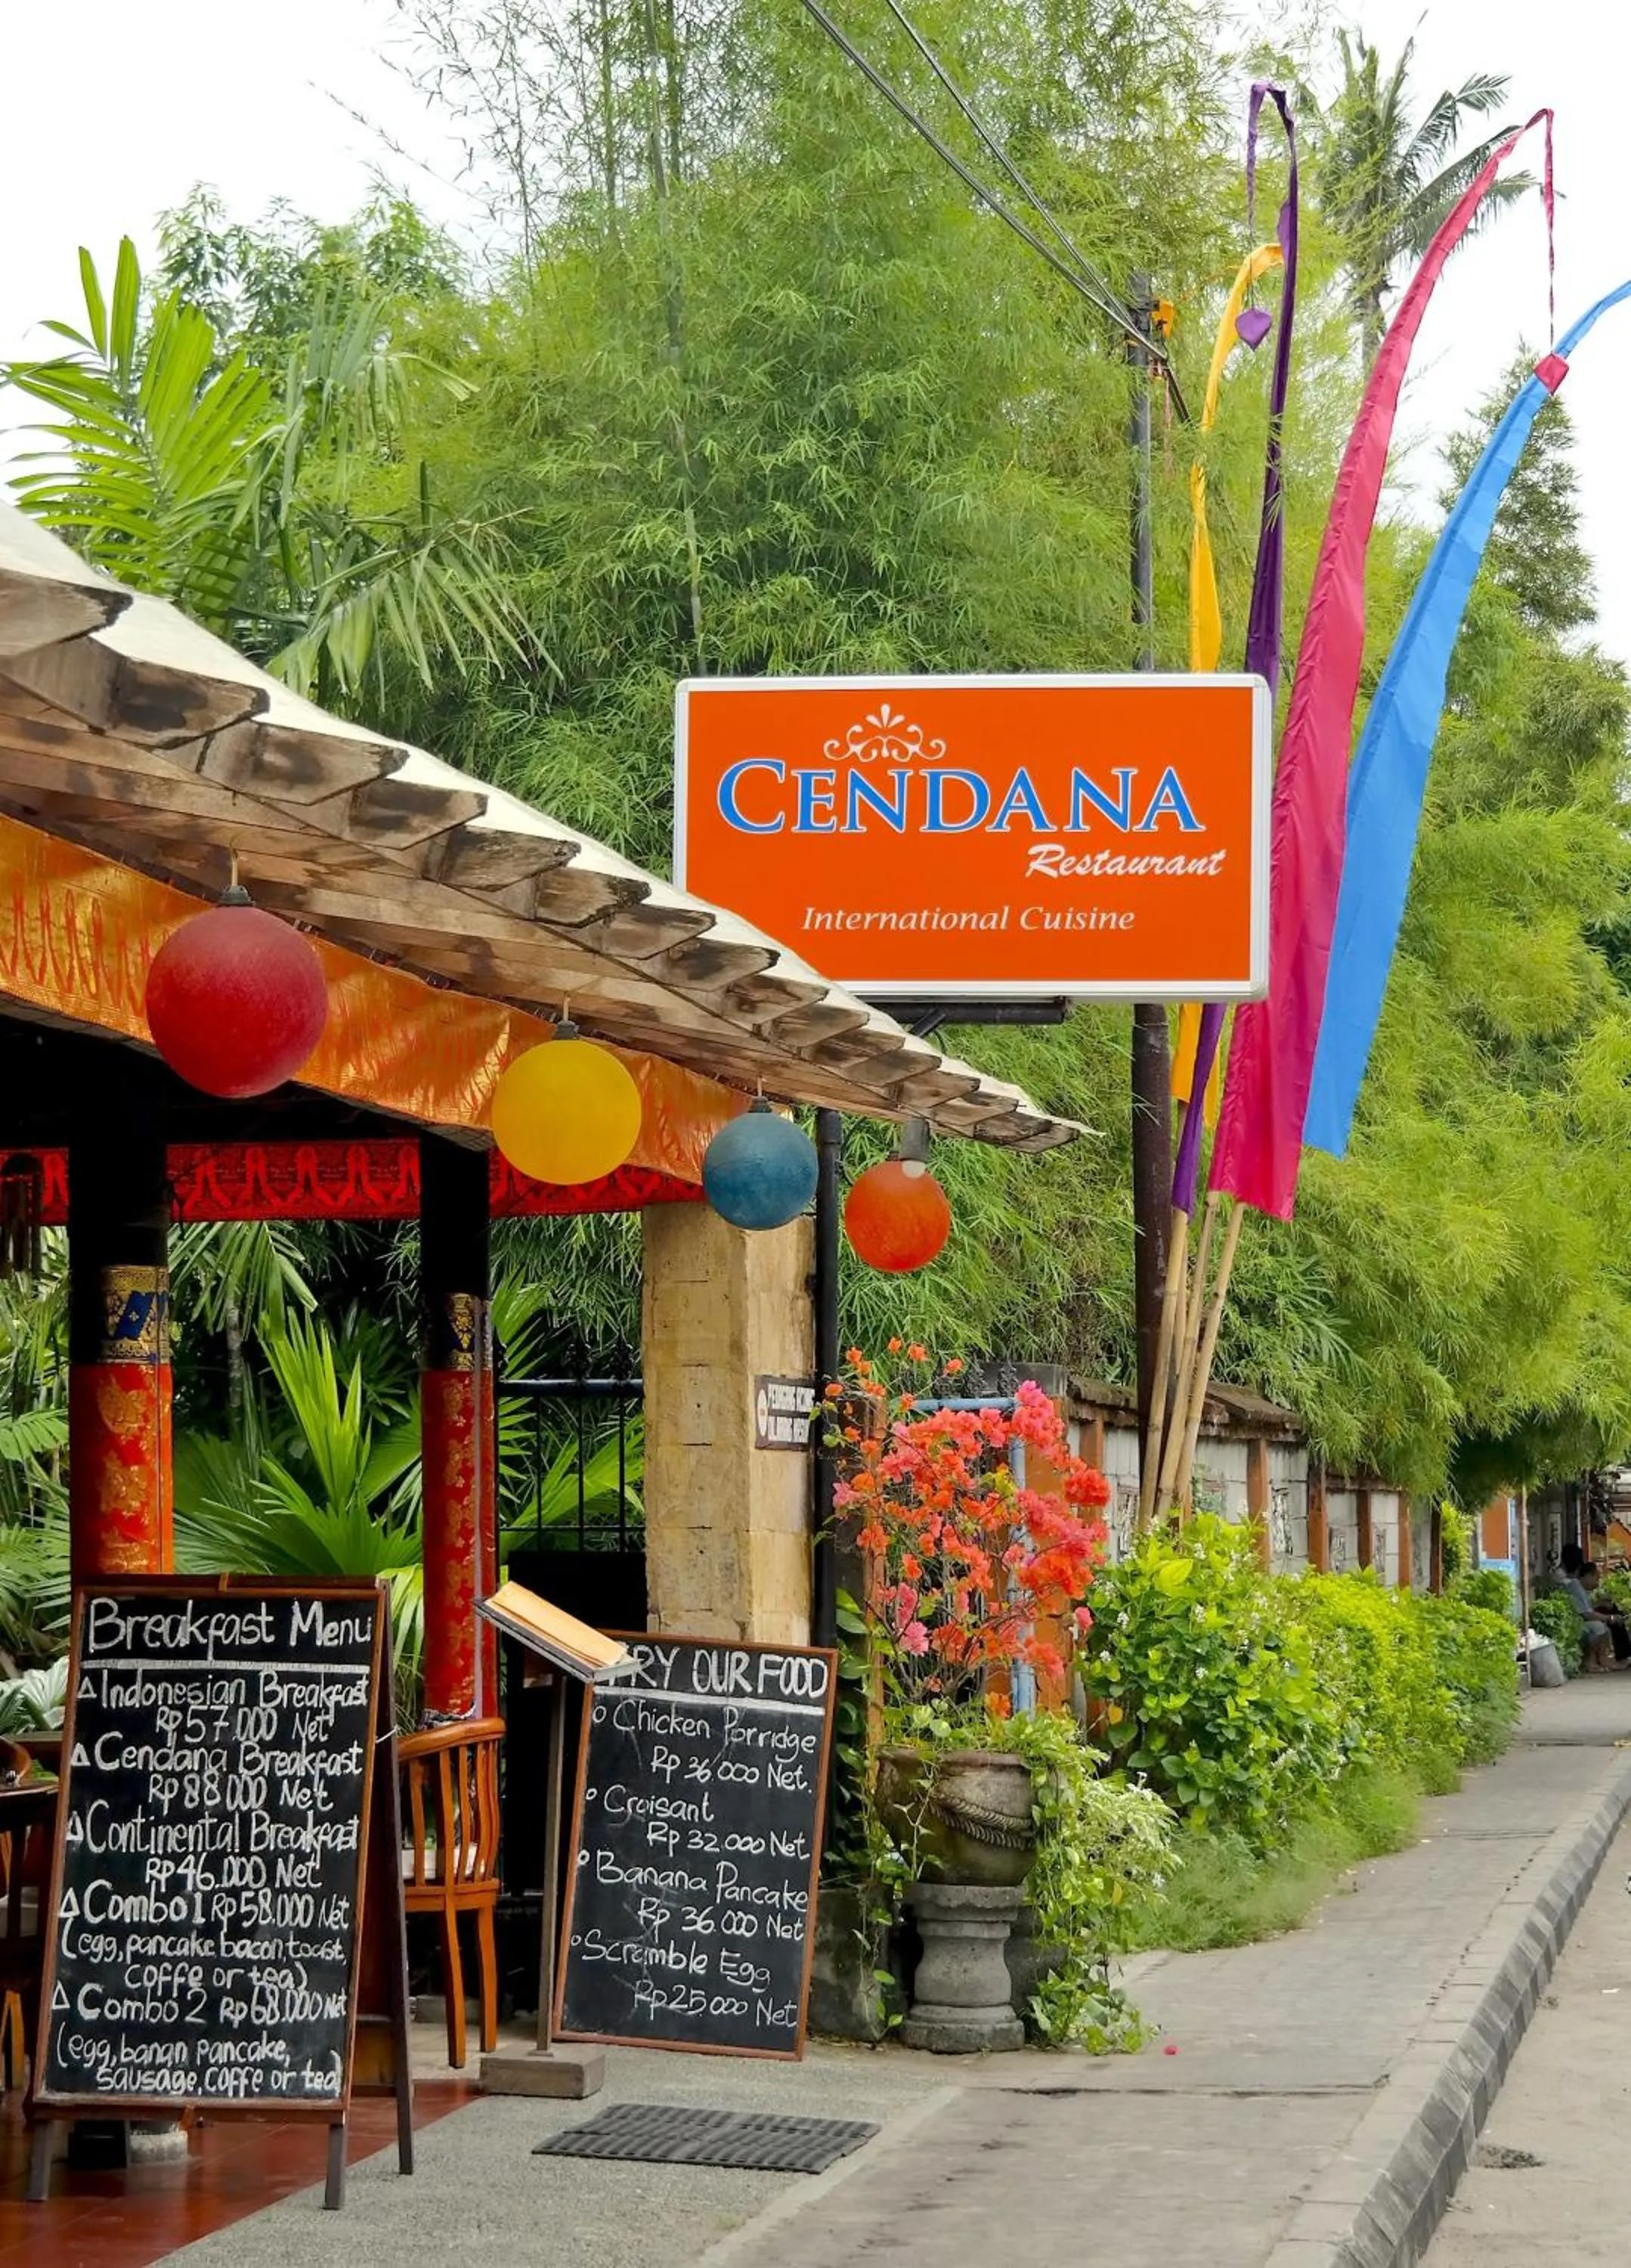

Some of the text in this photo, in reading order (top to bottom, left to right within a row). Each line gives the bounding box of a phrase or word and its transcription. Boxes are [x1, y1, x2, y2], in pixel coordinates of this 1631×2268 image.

[716, 757, 1205, 835] CENDANA
[1025, 843, 1226, 878] Restaurant
[802, 906, 1136, 931] International Cuisine
[88, 1597, 372, 1661] Breakfast Menu
[608, 1641, 828, 1699] RY OUR FOOD
[101, 1669, 369, 1725] Indonesian Breakfast
[292, 1710, 329, 1742] Net
[613, 1699, 816, 1763] Chicken Porridge
[239, 1738, 364, 1791] Breakfast
[651, 1746, 681, 1784] Rp
[280, 1779, 334, 1811] Net
[85, 1799, 359, 1869] Continental Breakfast
[647, 1821, 679, 1857] Rp
[770, 1830, 810, 1860] Net
[275, 1854, 323, 1888] Net
[596, 1851, 807, 1912] Banana Pancake
[84, 1879, 187, 1923] Combo
[318, 1894, 349, 1930] Net
[638, 1897, 670, 1944] Rp
[766, 1912, 804, 1941] Net
[213, 1967, 245, 1989] or
[582, 1929, 771, 1994] Scramble Egg
[78, 1982, 178, 2023] Combo
[323, 1988, 347, 2019] Net
[635, 1979, 667, 2021] Rp
[757, 1997, 797, 2028] Net
[271, 2068, 297, 2091] or
